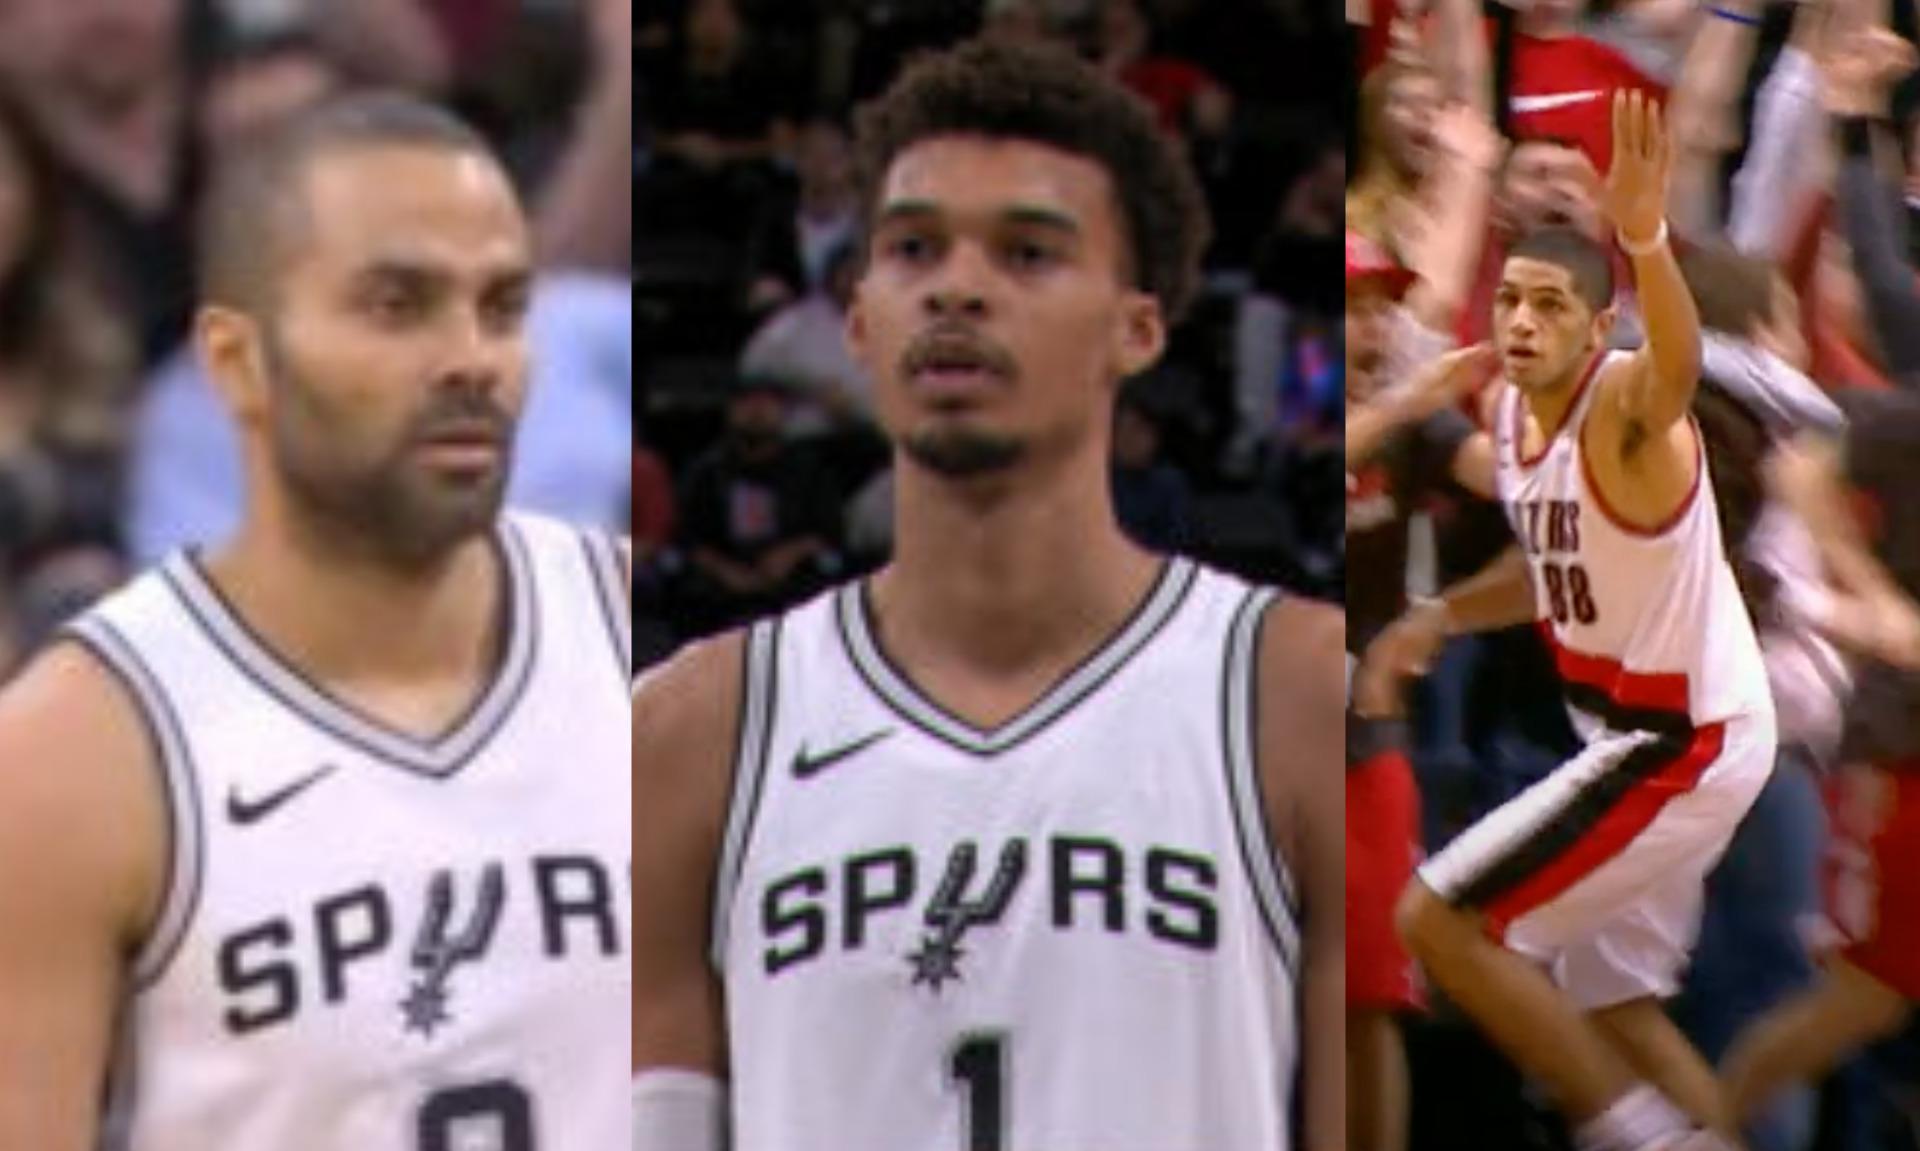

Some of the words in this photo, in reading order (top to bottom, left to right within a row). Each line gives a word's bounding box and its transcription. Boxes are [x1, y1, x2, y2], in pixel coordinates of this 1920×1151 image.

[1543, 564, 1598, 624] 88
[218, 855, 631, 1036] SPUR
[761, 835, 1219, 988] SPURS
